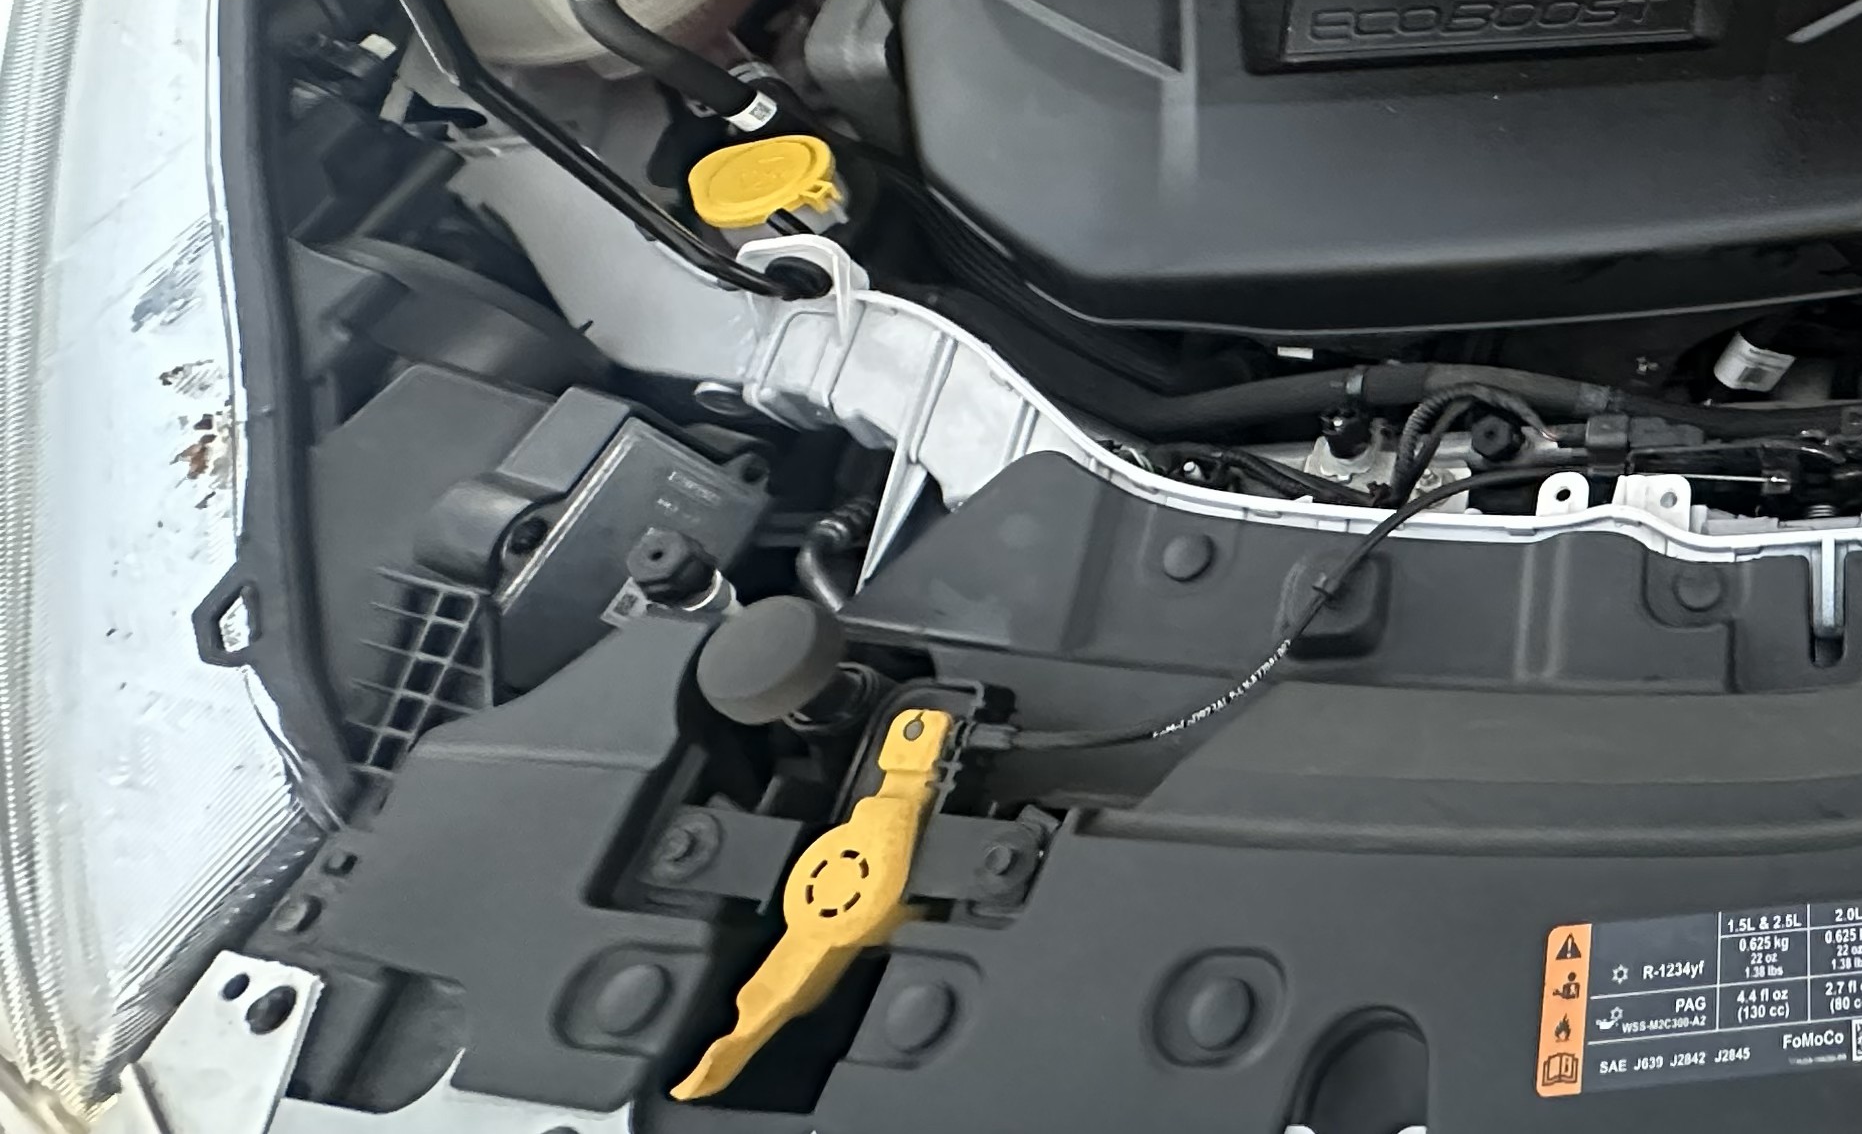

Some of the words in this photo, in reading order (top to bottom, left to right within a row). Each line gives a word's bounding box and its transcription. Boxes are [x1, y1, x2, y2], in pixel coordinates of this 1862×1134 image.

[1728, 917, 1755, 932] 1.5L
[1759, 916, 1769, 930] &
[1773, 913, 1802, 928] 2.5L
[1739, 936, 1771, 951] 0.625
[1774, 935, 1789, 951] kg
[1824, 928, 1857, 944] 0.625
[1750, 953, 1763, 964] 22
[1765, 952, 1777, 963] oz
[1837, 945, 1848, 956] 22
[1643, 960, 1705, 980] R-1234yf
[1745, 966, 1765, 978] 1.38
[1768, 965, 1784, 976] lbs
[1831, 958, 1851, 970] 1.38
[1736, 989, 1757, 1004] 4.4
[1760, 988, 1769, 1002] fl
[1772, 989, 1788, 1001] oz
[1825, 982, 1845, 996] 2.7
[1848, 980, 1857, 993] fl
[1675, 996, 1707, 1013] PAG
[1737, 1004, 1765, 1023] (130
[1769, 1002, 1790, 1018] cc)
[1829, 996, 1850, 1014] (80
[1782, 1030, 1844, 1049] FoMoCo
[1599, 1059, 1627, 1074] SAE
[1714, 1047, 1751, 1063] J2845
